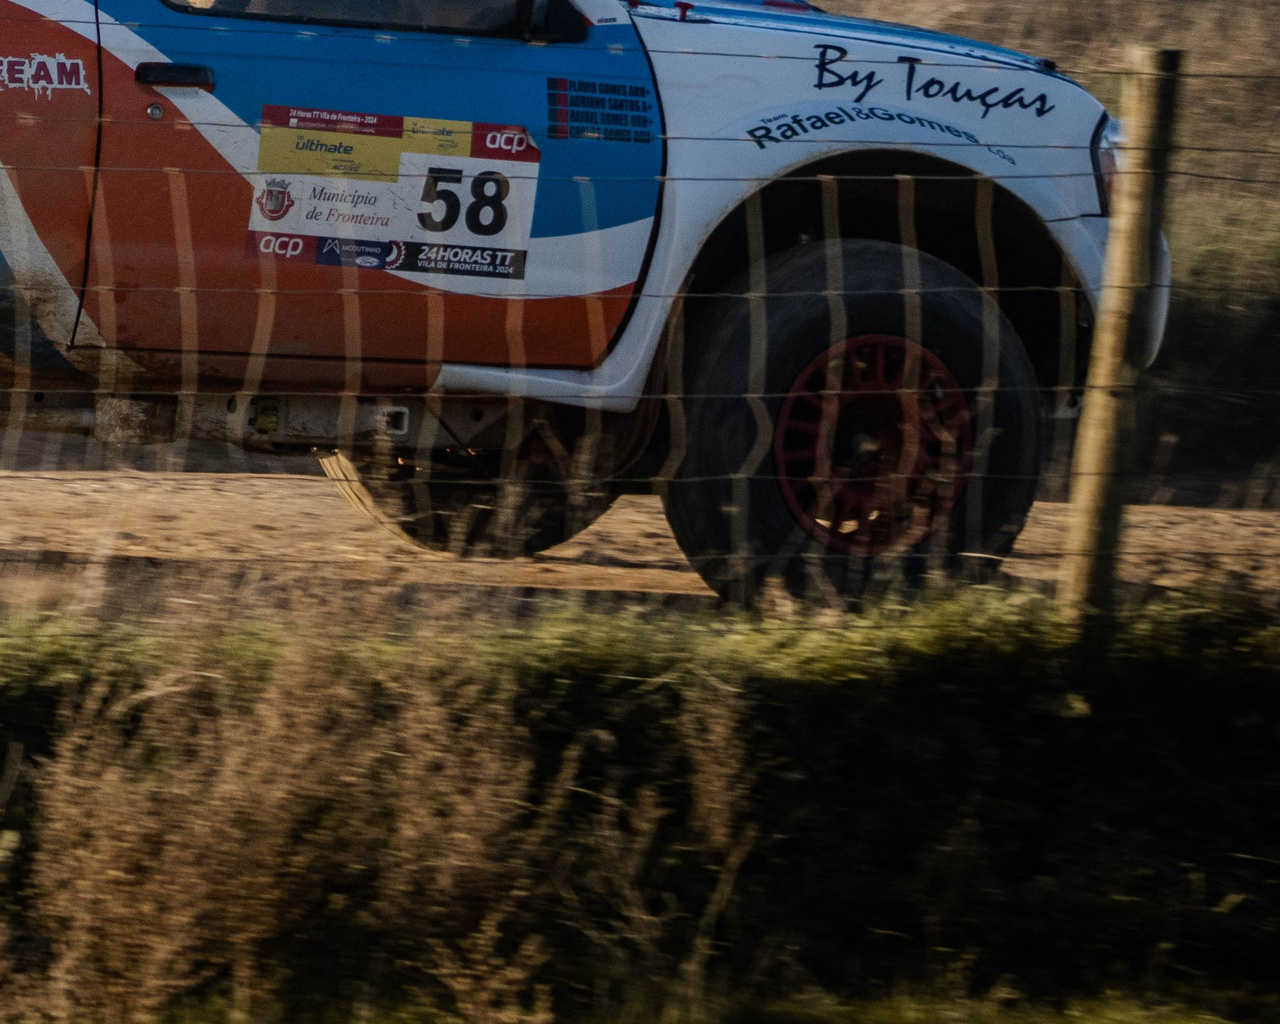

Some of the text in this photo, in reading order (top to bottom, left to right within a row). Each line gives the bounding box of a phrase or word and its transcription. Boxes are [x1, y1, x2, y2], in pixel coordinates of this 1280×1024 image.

[814, 44, 1055, 119] By Touças
[760, 113, 788, 125] Team
[295, 139, 353, 154] ultimate
[486, 131, 527, 153] acp
[309, 186, 377, 208] Município
[416, 167, 510, 236] 58
[305, 206, 389, 226] de Fronteira
[260, 235, 303, 258] acp
[417, 260, 513, 273] VILA DE FRONTEIRA 2024
[495, 251, 515, 266] TT
